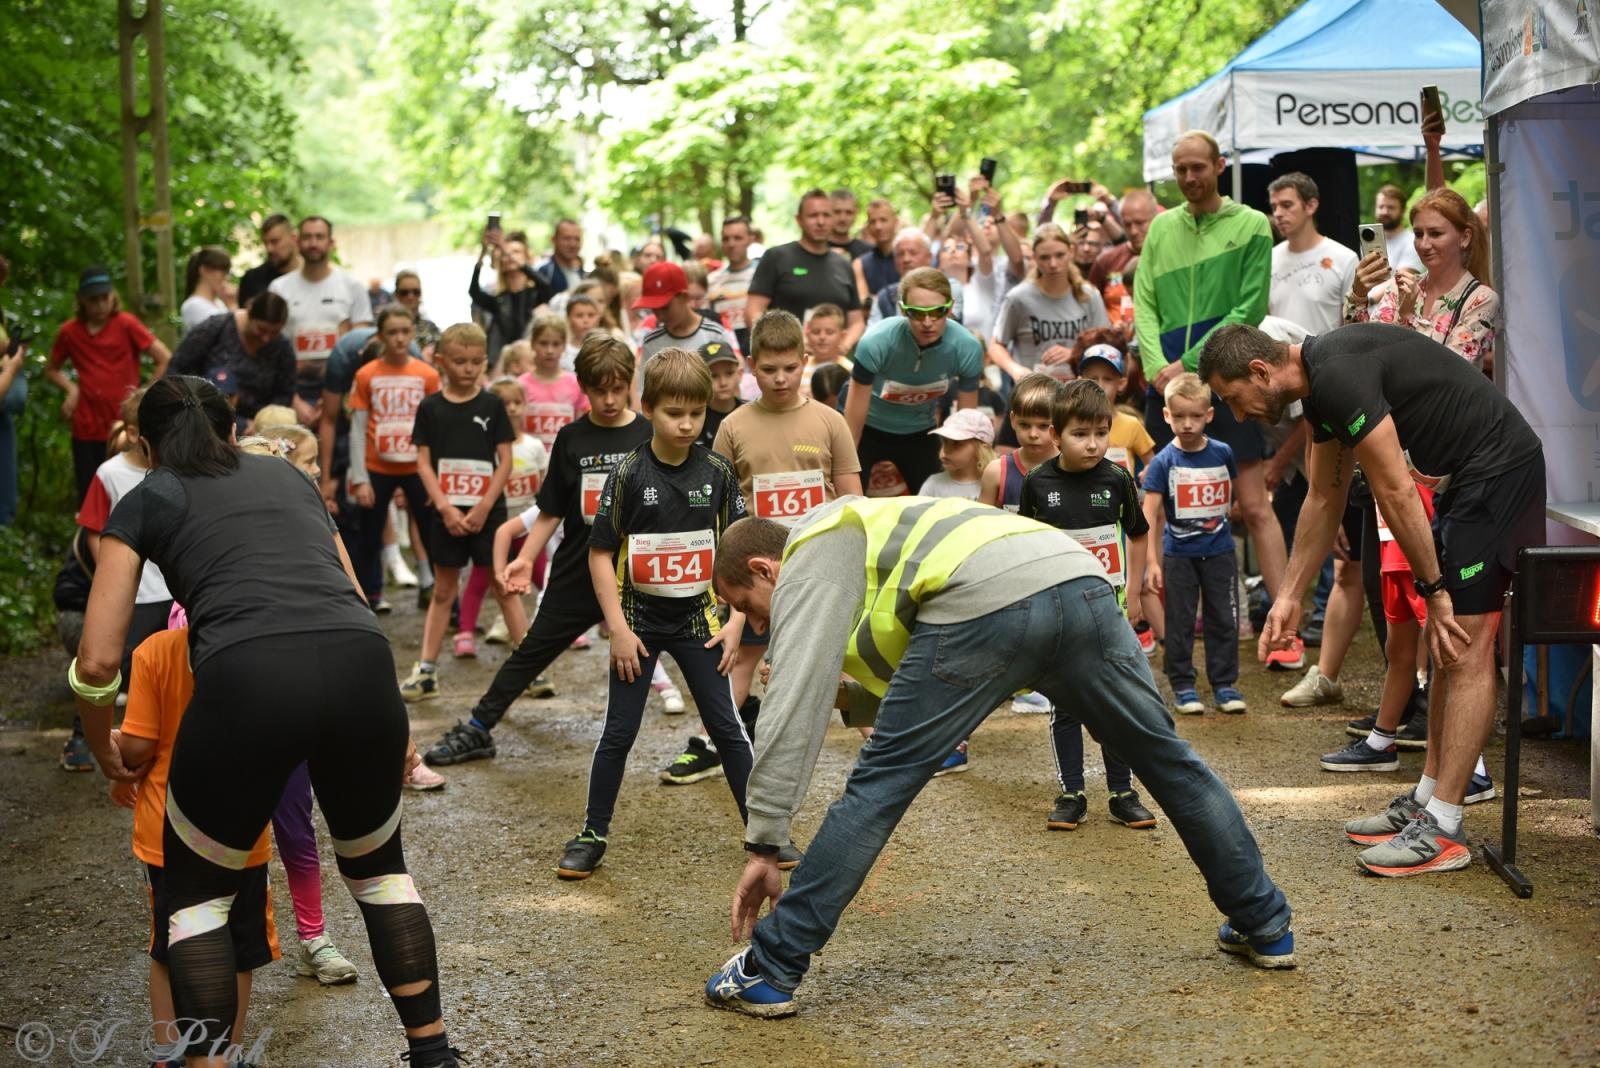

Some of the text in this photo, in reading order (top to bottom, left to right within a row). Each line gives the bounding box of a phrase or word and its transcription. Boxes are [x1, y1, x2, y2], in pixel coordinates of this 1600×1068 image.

[580, 452, 628, 467] GTX SER
[446, 475, 483, 495] 159
[1187, 483, 1225, 507] 184
[767, 489, 812, 516] 161
[690, 539, 705, 547] 4500
[647, 553, 703, 583] 154
[1091, 547, 1112, 572] 3
